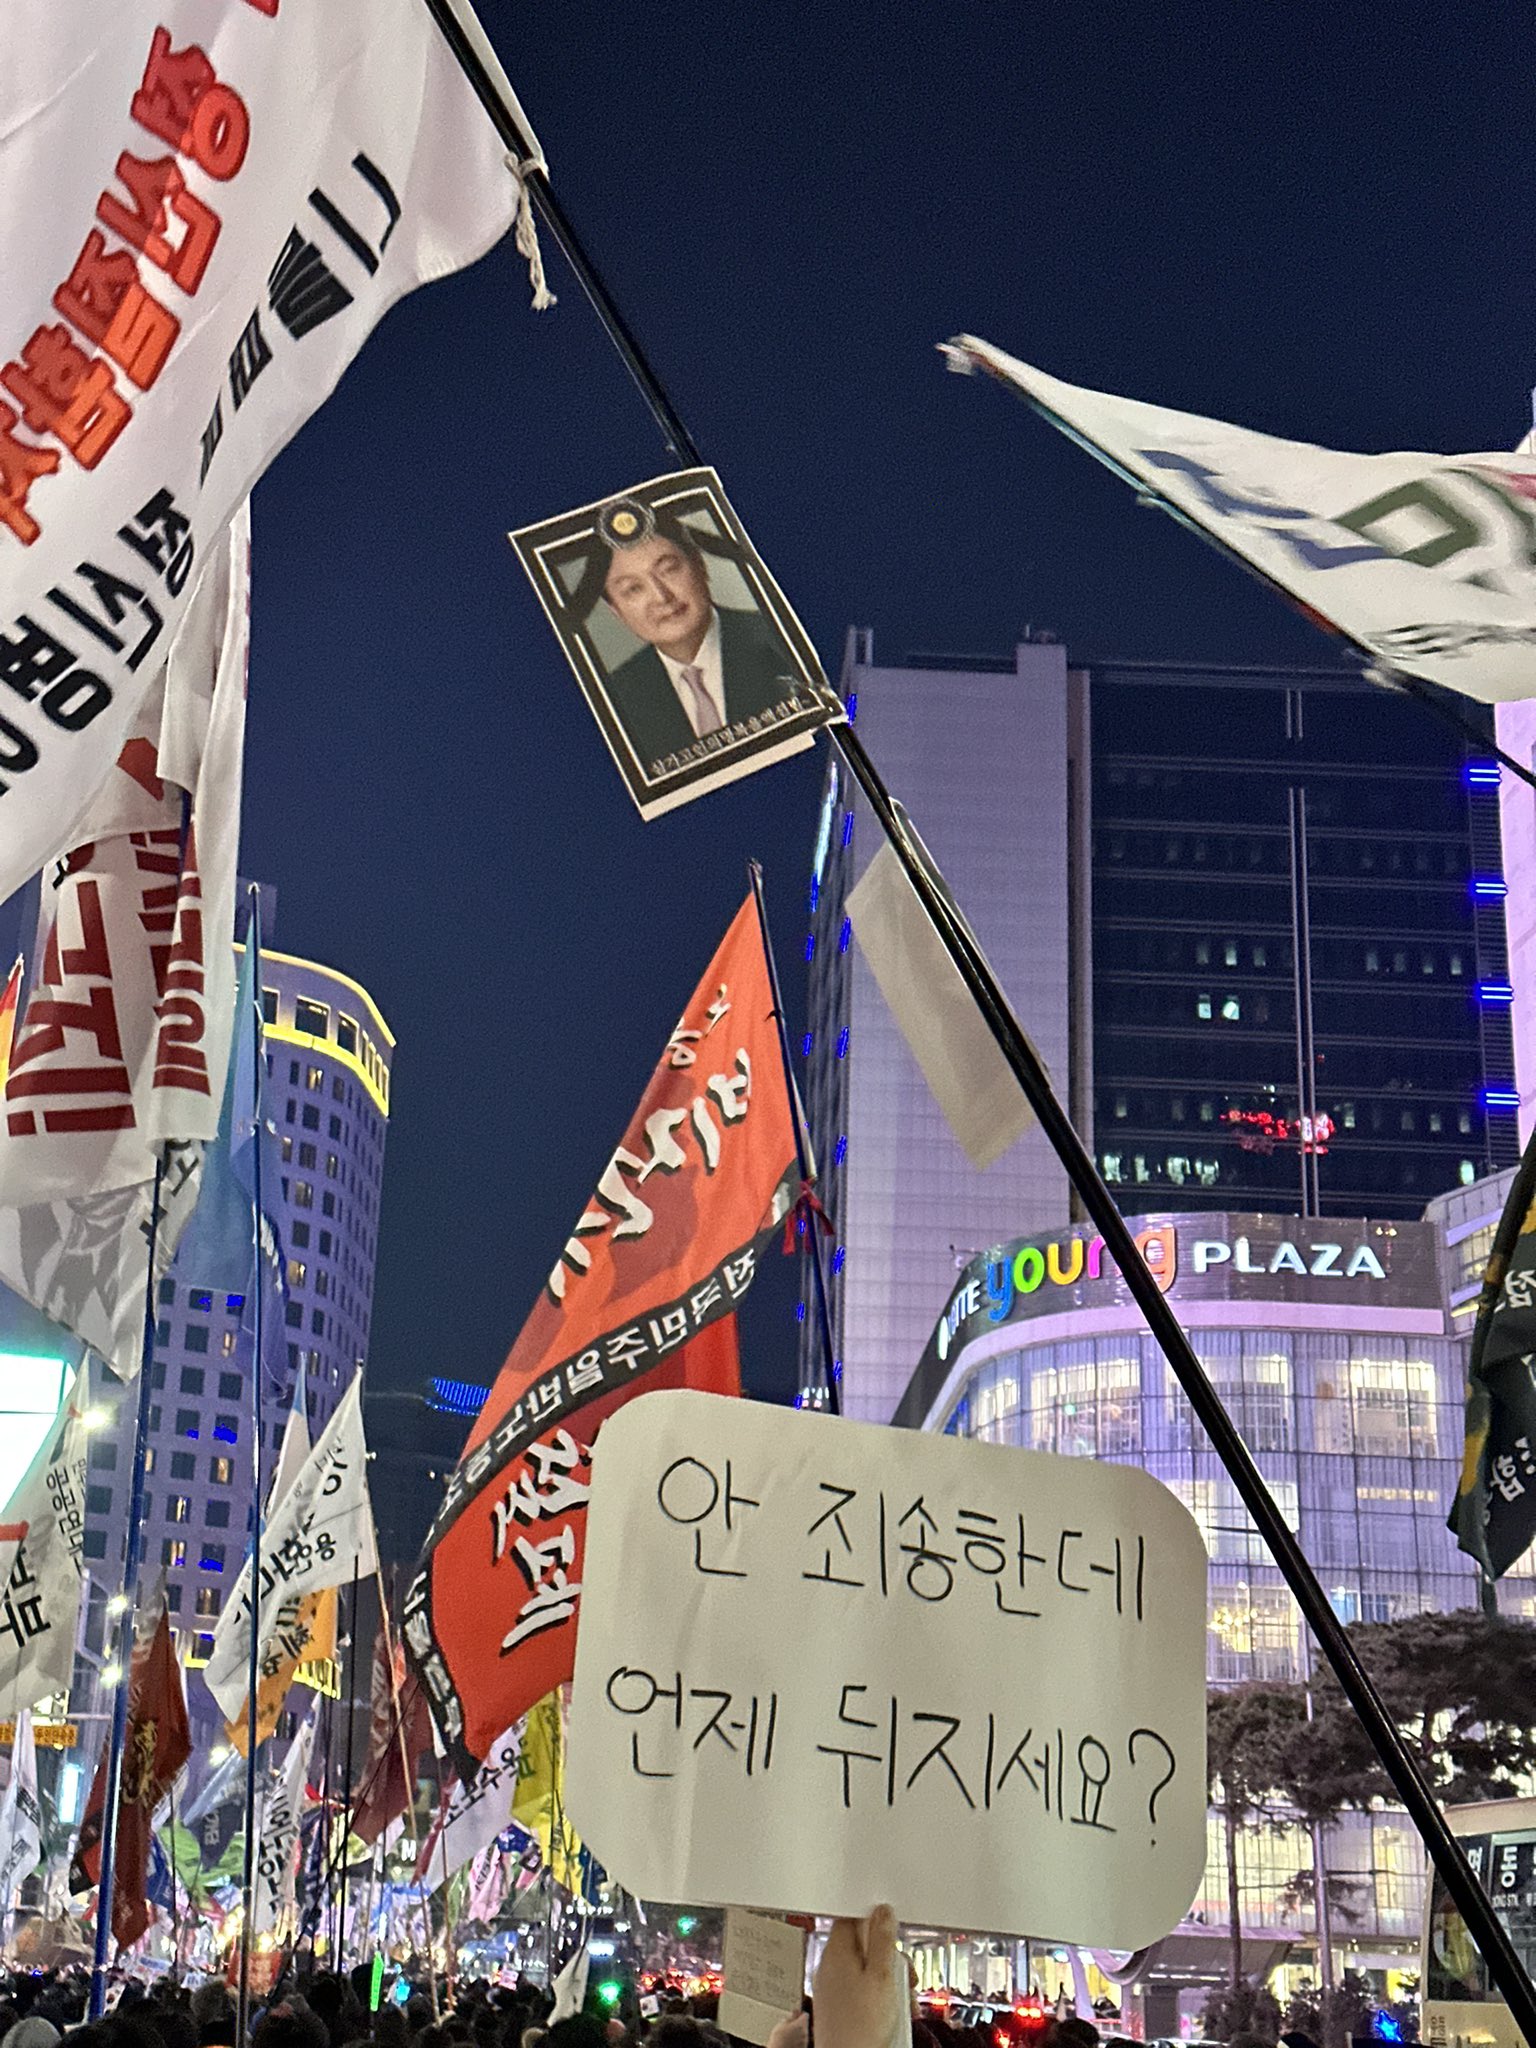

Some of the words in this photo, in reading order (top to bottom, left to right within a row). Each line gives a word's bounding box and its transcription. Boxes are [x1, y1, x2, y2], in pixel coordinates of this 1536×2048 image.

[1194, 1236, 1386, 1279] PLAZA
[658, 1456, 760, 1577] 안
[803, 1482, 1145, 1621] 죄송한데
[606, 1666, 777, 1778] 언제
[817, 1685, 1177, 1847] 뒤지세요?
